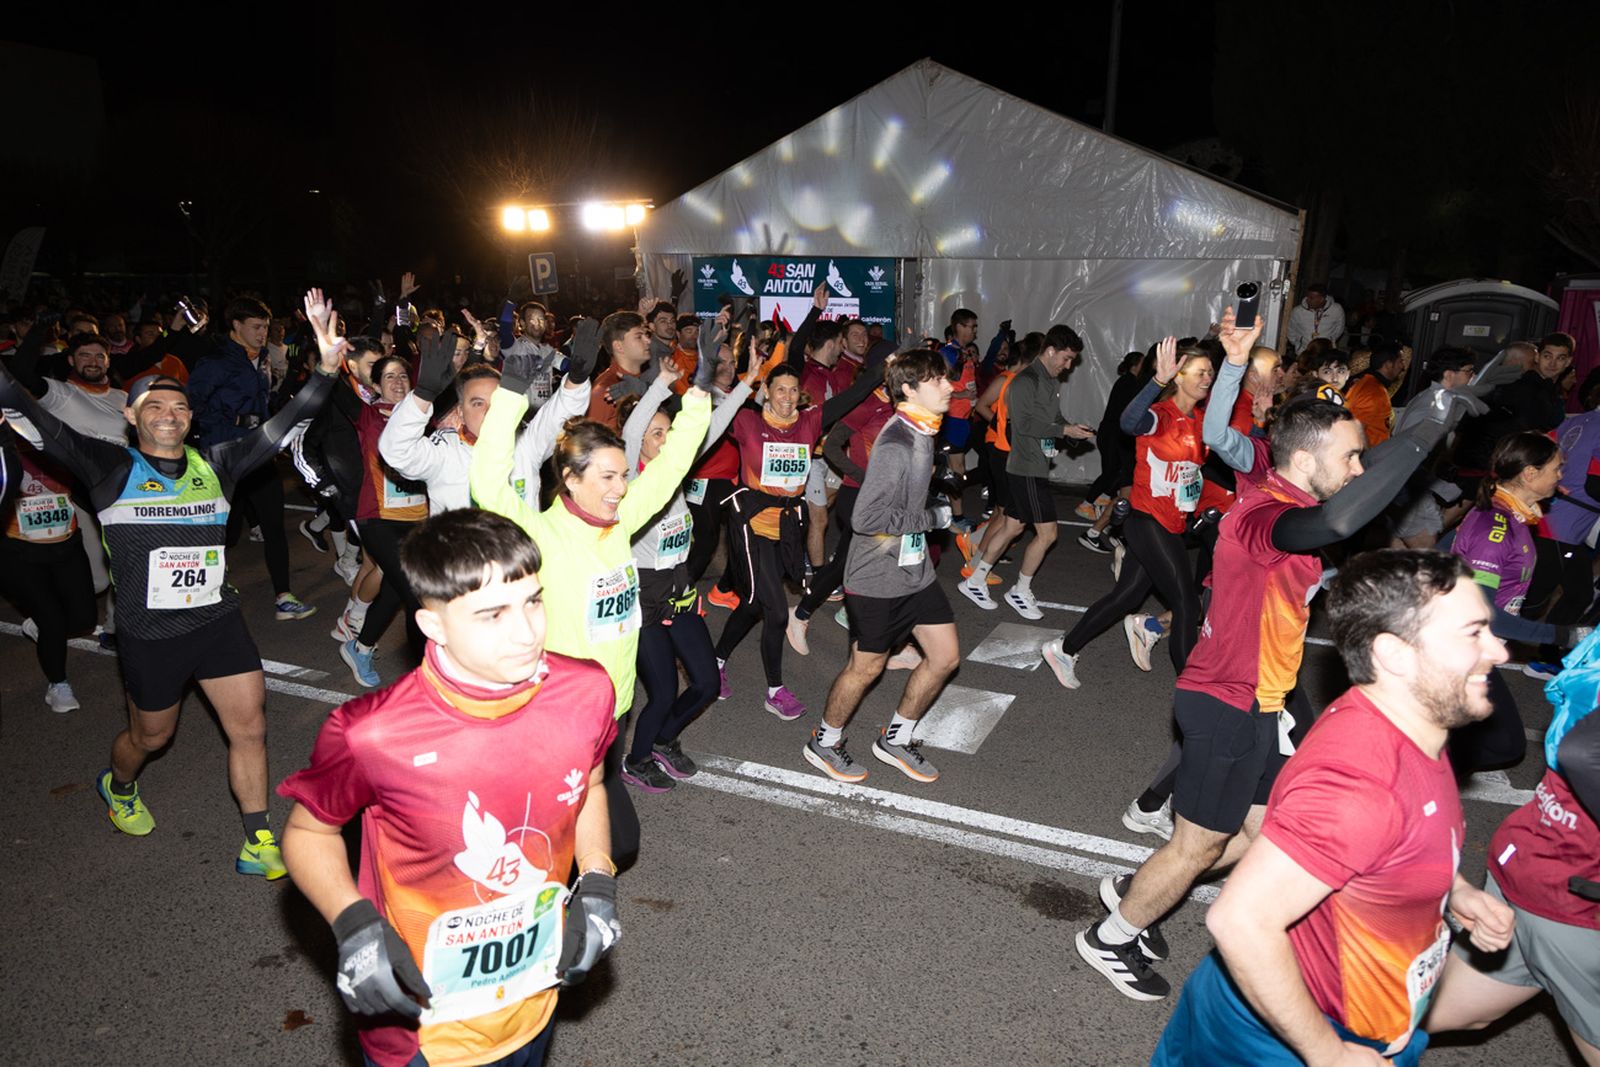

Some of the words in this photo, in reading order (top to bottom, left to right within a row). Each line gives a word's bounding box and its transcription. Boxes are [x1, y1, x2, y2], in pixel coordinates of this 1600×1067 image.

[535, 258, 551, 280] P
[768, 262, 785, 279] 43
[785, 263, 816, 278] SAN
[737, 279, 747, 290] 43
[763, 275, 814, 294] ANTÓN
[833, 280, 844, 291] 43
[769, 458, 806, 473] 13655
[27, 483, 43, 494] 43
[25, 508, 69, 526] 13348
[159, 561, 176, 569] SAN
[171, 568, 207, 588] 264
[486, 855, 521, 887] 43
[465, 910, 509, 928] NOCHE
[445, 930, 476, 946] SAN
[461, 921, 540, 978] 7007
